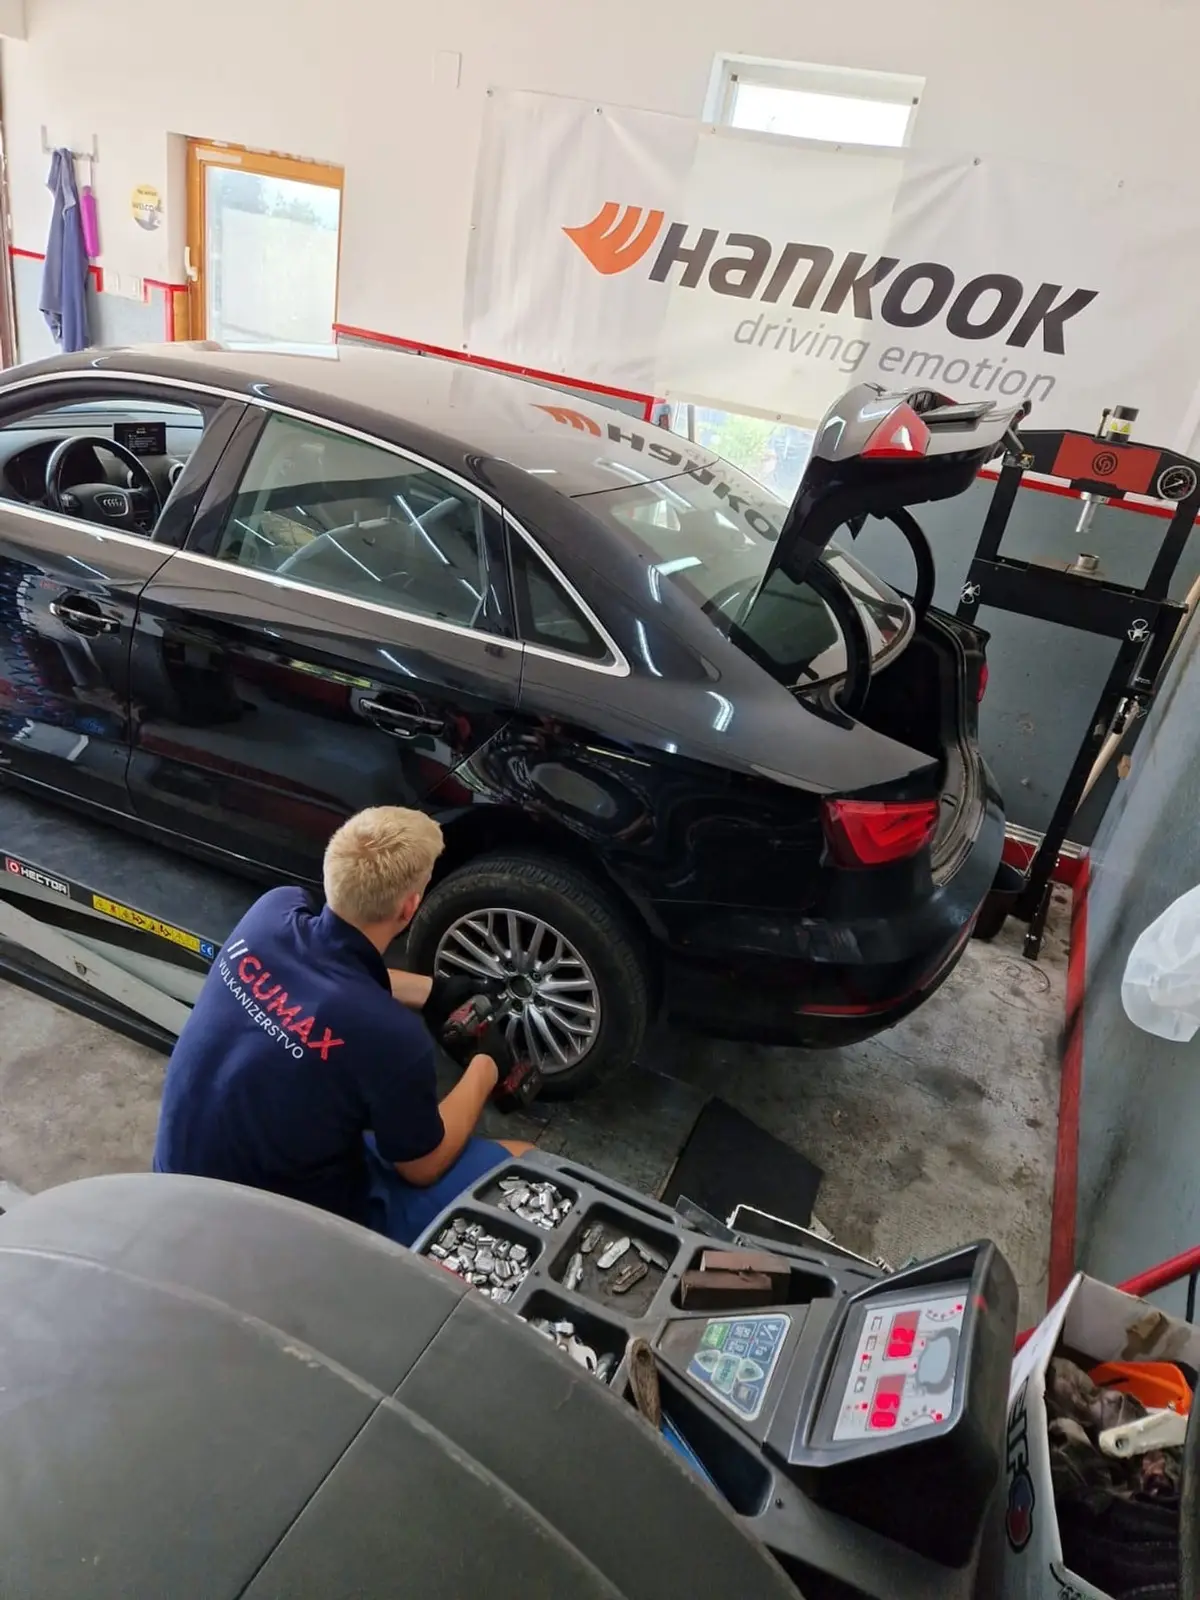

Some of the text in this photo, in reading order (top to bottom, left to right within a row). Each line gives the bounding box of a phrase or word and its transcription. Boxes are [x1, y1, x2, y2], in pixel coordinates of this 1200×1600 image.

[733, 313, 1056, 402] driving emotion
[20, 866, 68, 895] HECTOR
[219, 957, 304, 1059] VULKANIZERSTVO
